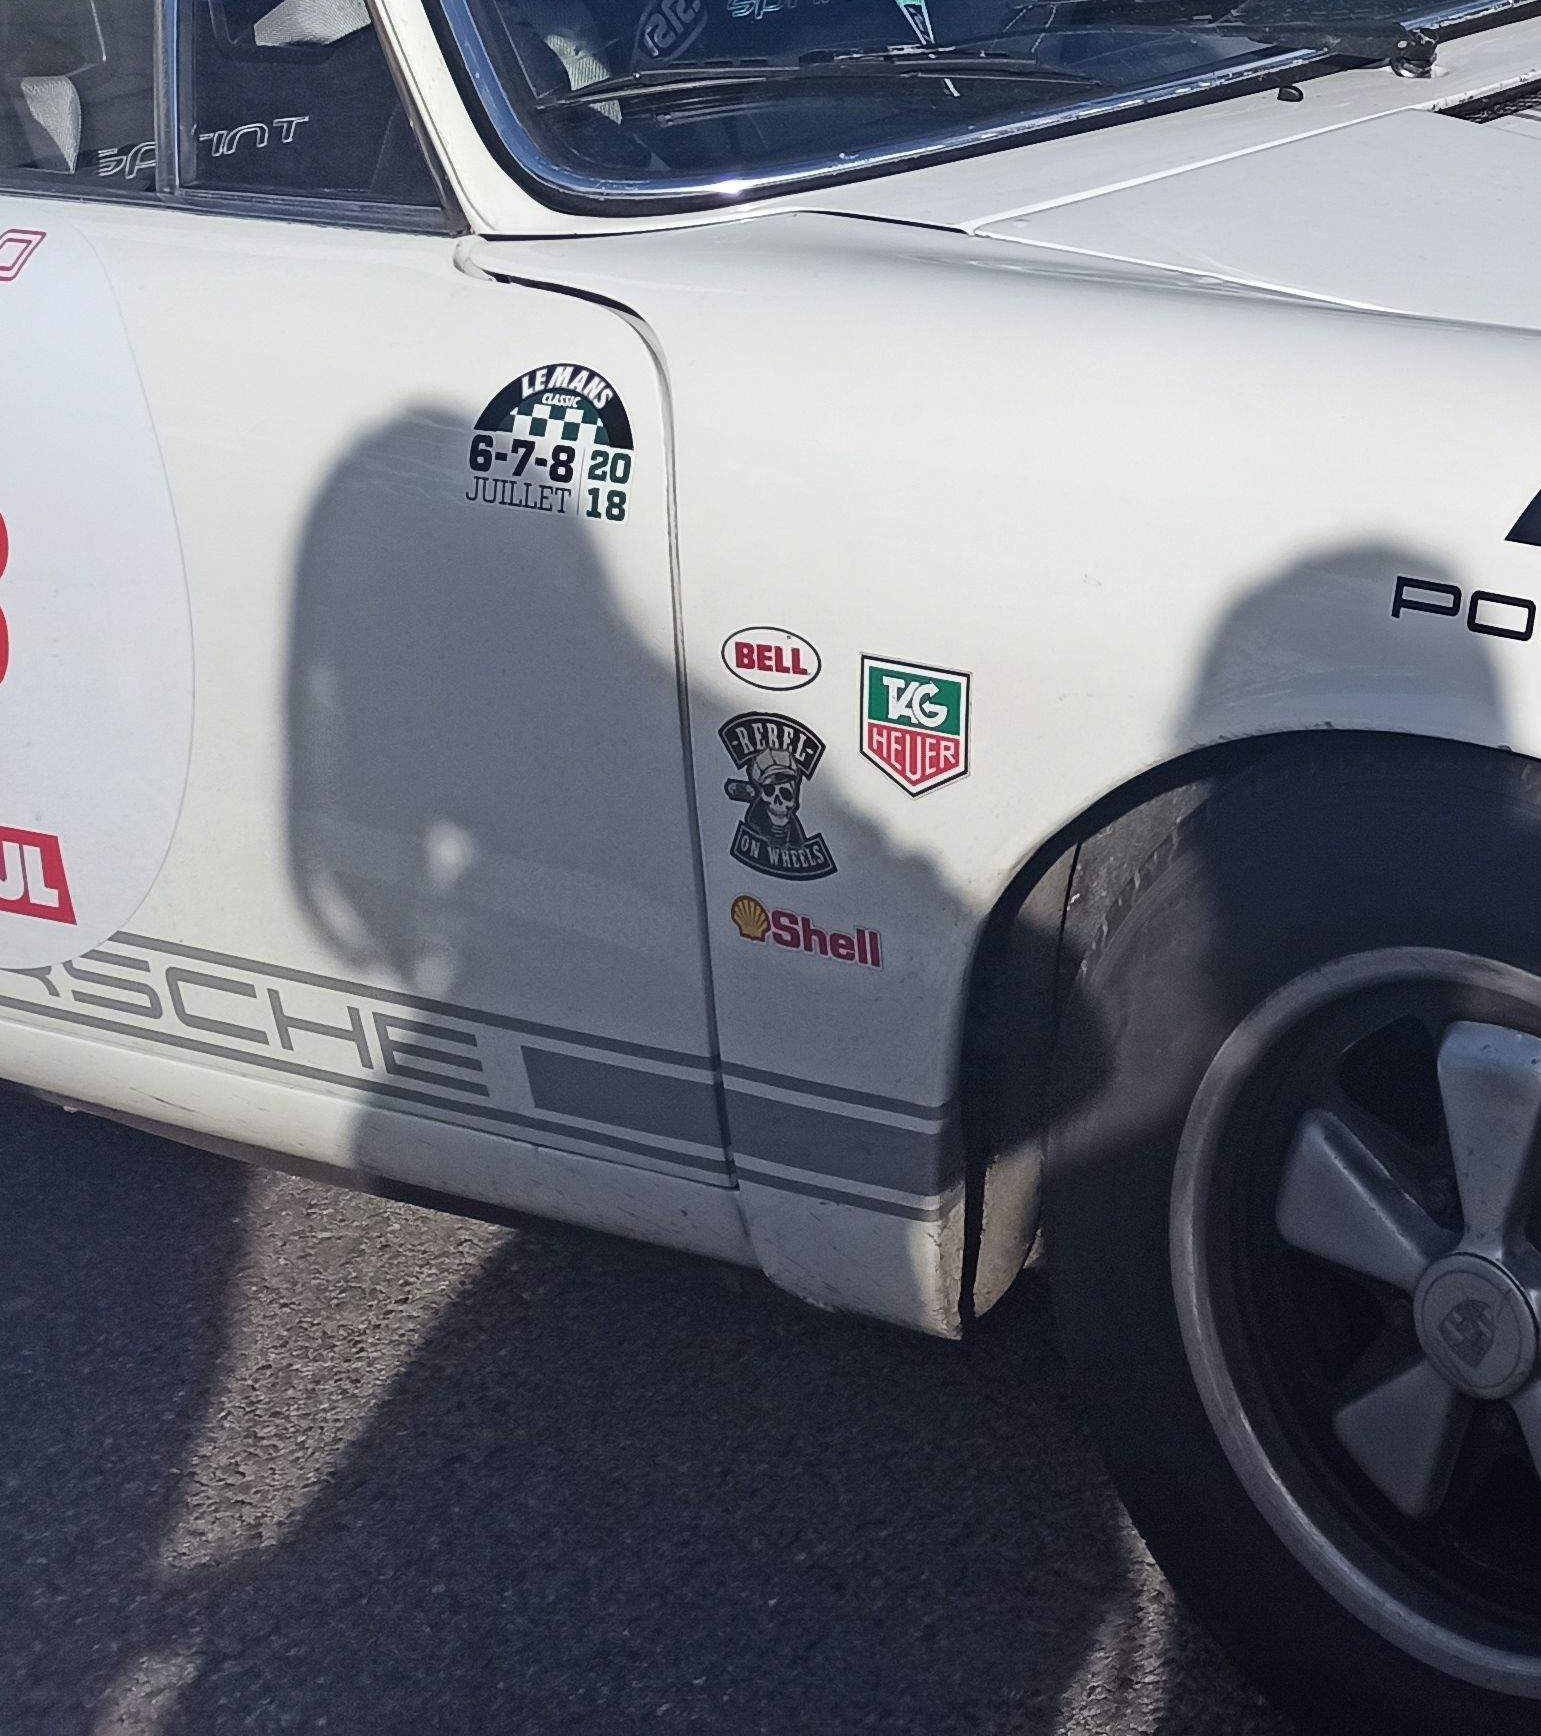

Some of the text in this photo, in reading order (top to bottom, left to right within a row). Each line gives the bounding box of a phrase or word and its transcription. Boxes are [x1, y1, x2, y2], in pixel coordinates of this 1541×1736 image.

[97, 115, 310, 180] spint
[521, 364, 614, 411] LE MANS
[541, 392, 582, 409] CLASSIC
[469, 434, 577, 484] 6-7-8
[587, 449, 633, 485] 20
[465, 475, 573, 515] JUILLET
[586, 487, 628, 522] 18
[734, 641, 811, 677] BELL
[882, 675, 949, 729] TAG
[736, 720, 808, 761] REBEL
[871, 725, 958, 782] HEUER
[739, 834, 826, 870] ON WHEELS
[770, 908, 883, 969] Shell
